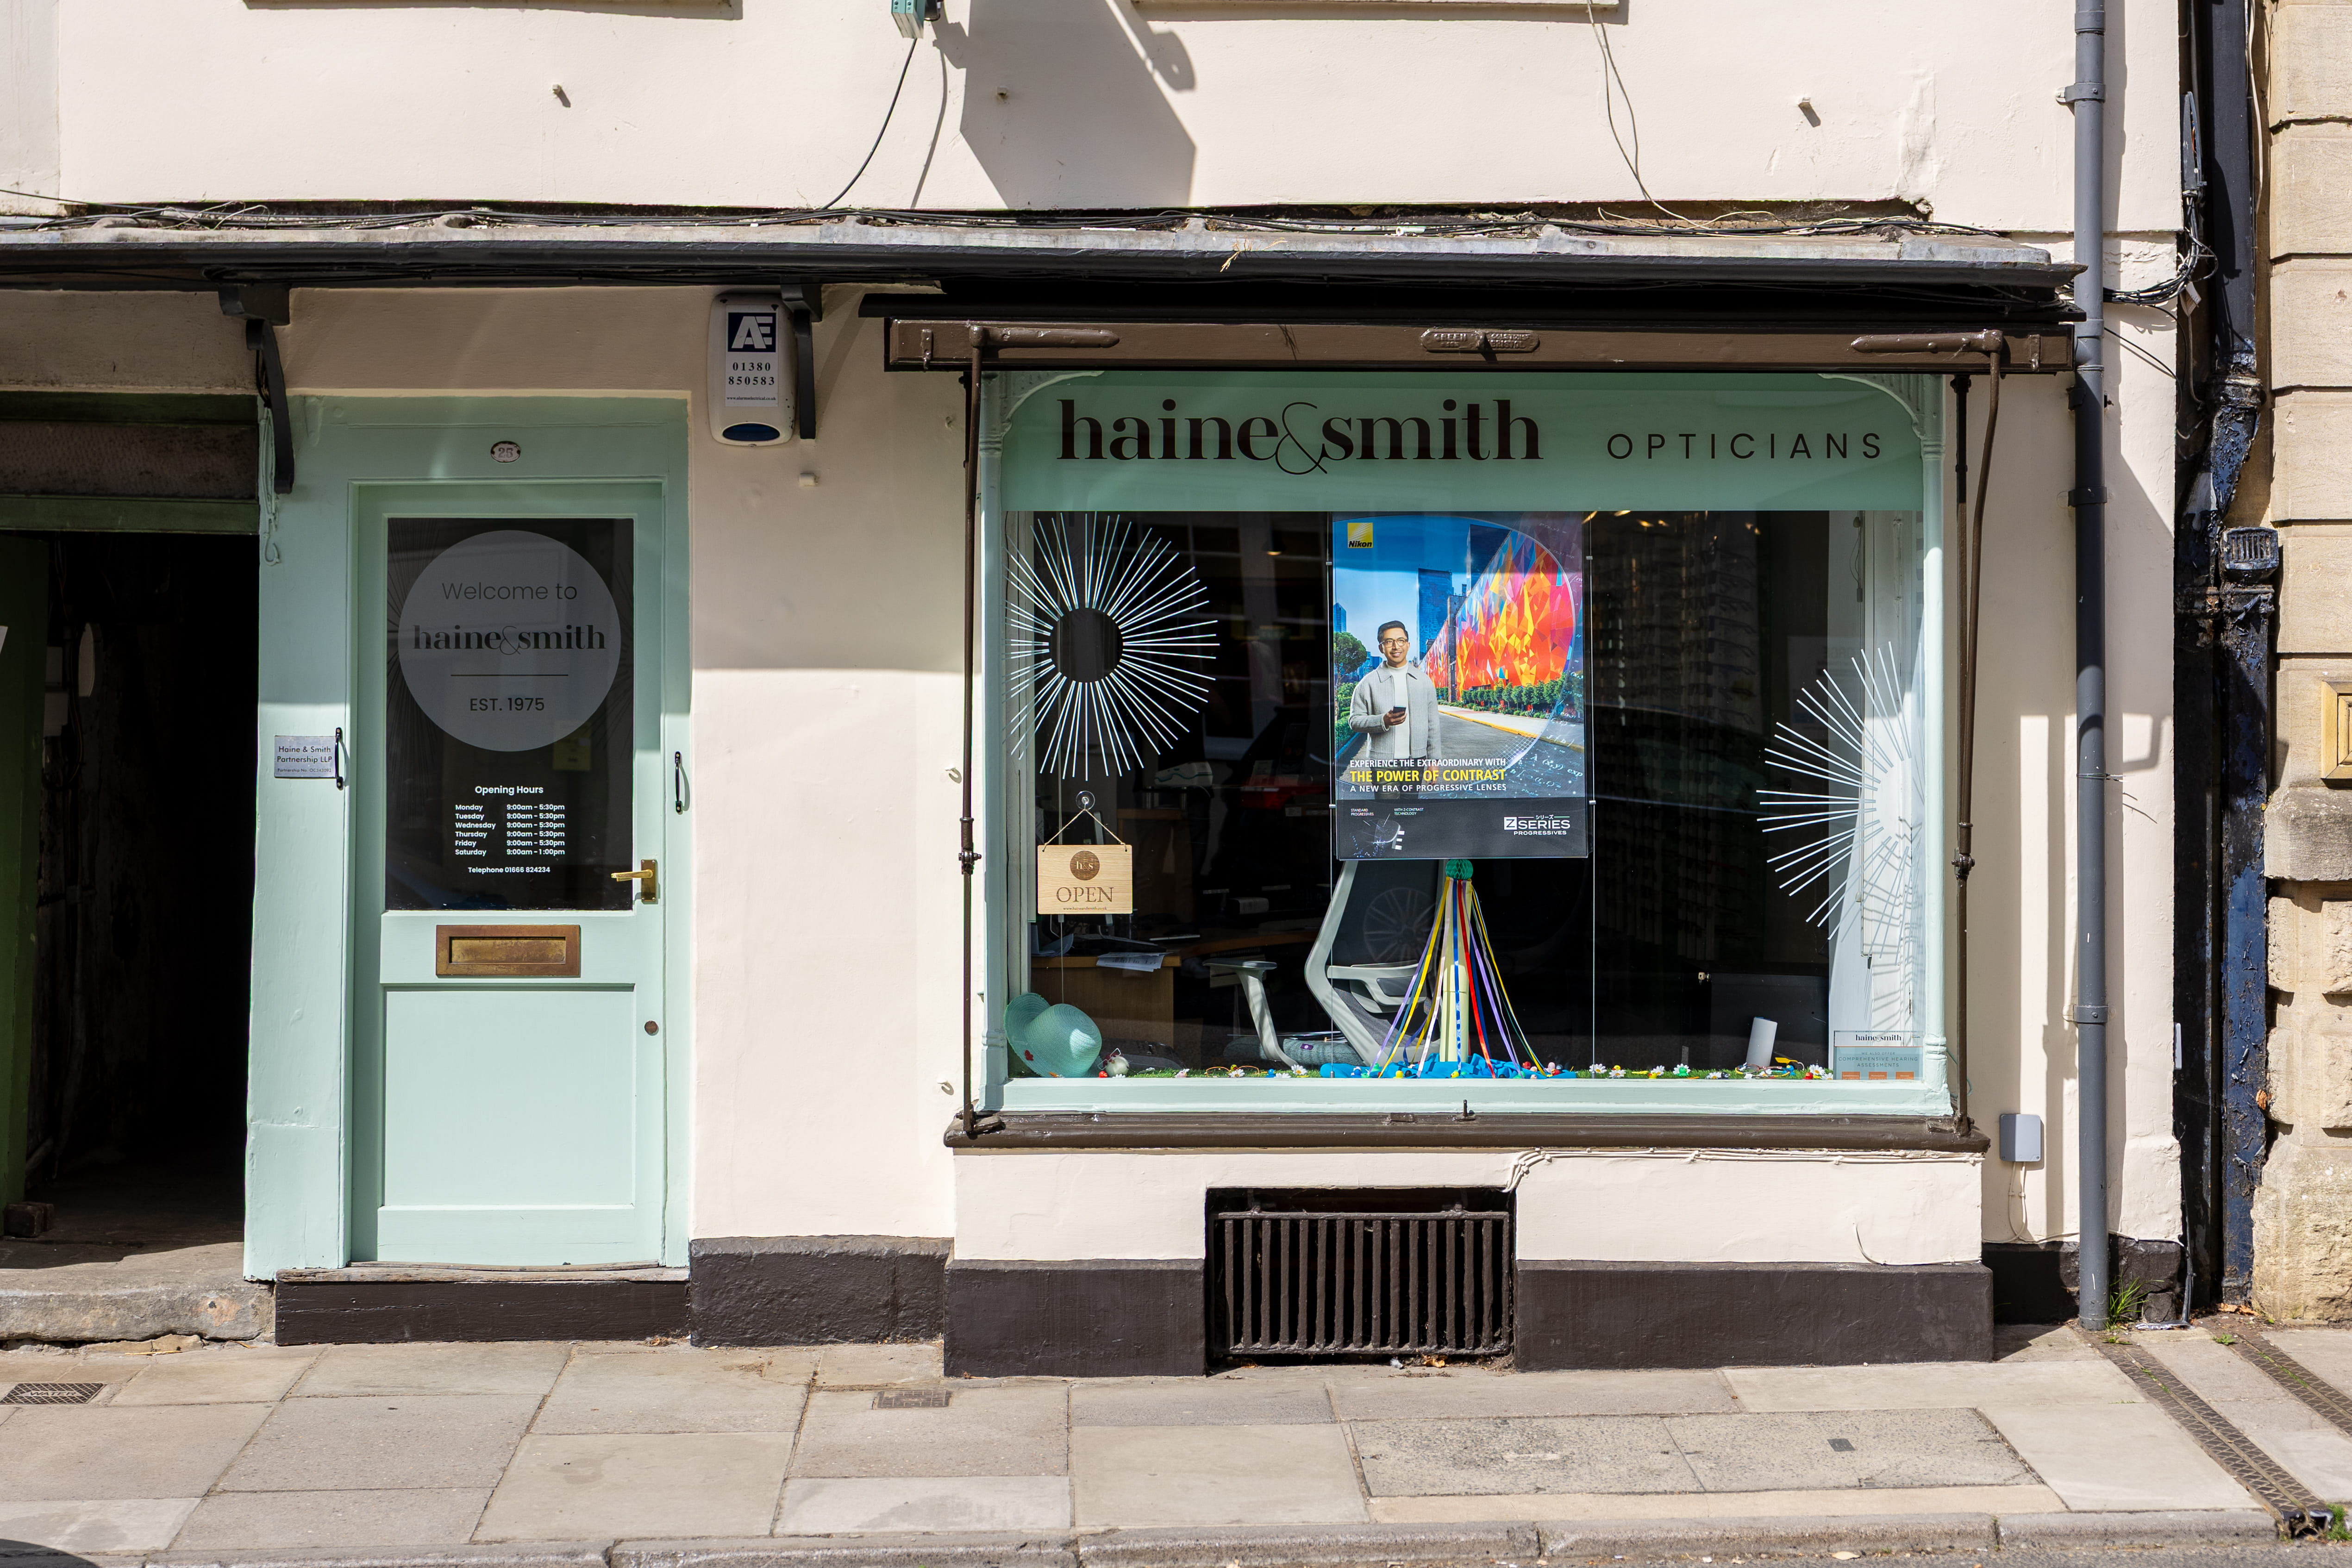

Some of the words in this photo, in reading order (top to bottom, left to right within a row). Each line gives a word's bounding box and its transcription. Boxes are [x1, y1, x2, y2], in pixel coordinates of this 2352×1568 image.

[732, 362, 770, 371] 01380
[728, 376, 775, 385] 850583
[1057, 399, 1544, 475] haine&smith
[1607, 433, 1881, 459] OPTICIANS
[498, 447, 513, 458] 25
[442, 582, 548, 600] Welcome
[556, 583, 577, 600] to
[413, 625, 606, 655] haine&smith
[470, 698, 502, 711] EST.
[507, 698, 544, 711] 1975
[277, 756, 318, 764] Partnership
[1417, 758, 1483, 767] EXTRAORDINARY
[1483, 758, 1506, 766] WITH
[1350, 771, 1372, 782] THE
[1377, 770, 1420, 781] POWER
[1423, 770, 1439, 781] OF
[1443, 769, 1505, 781] CONTRAST
[1567, 768, 1583, 777] exp
[475, 786, 514, 796] Opening
[1518, 820, 1570, 830] SERIES
[1076, 861, 1093, 871] h&s
[1056, 887, 1114, 902] OPEN
